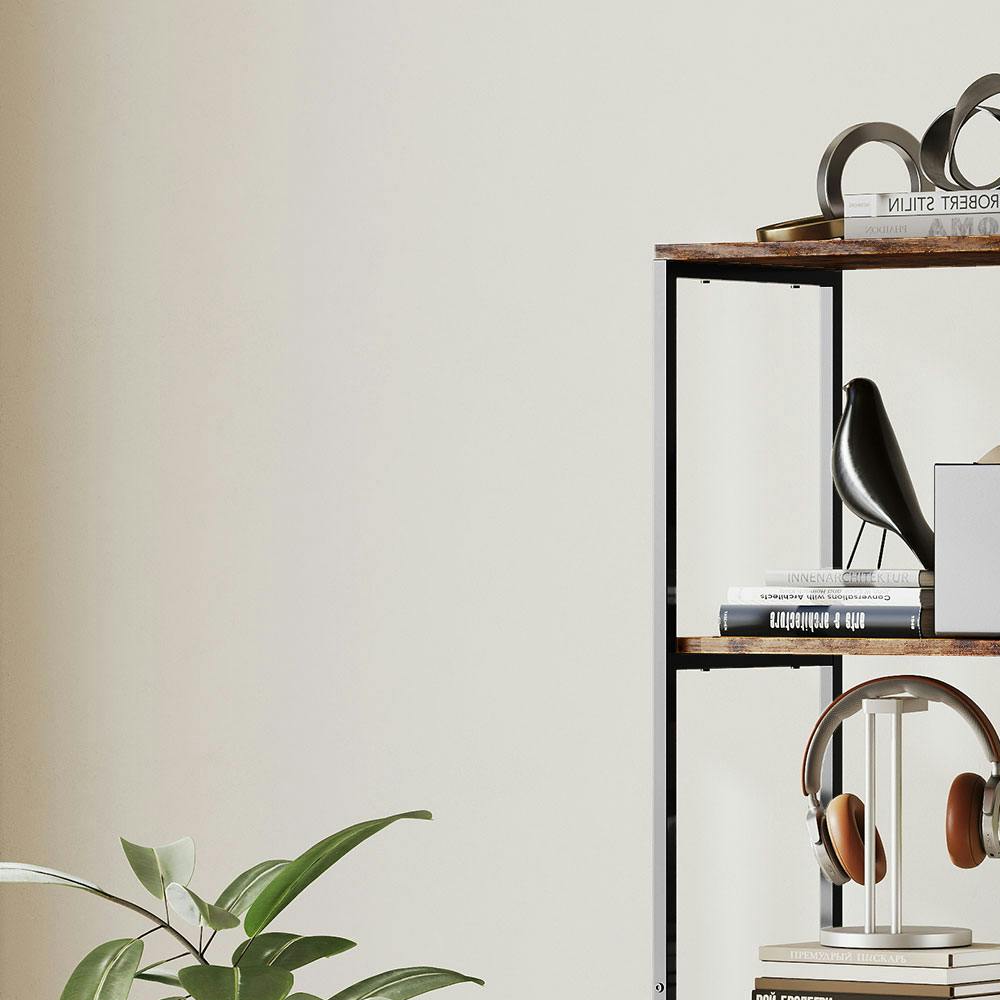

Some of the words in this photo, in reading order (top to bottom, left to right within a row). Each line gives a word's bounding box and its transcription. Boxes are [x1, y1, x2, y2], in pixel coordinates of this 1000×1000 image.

[787, 571, 909, 585] INNENARCHITEKTUR
[806, 594, 826, 602] with
[827, 594, 891, 602] Conversations
[769, 610, 830, 633] architecture
[845, 611, 865, 632] arts
[790, 950, 853, 962] ПРЕМУДРЫЙ
